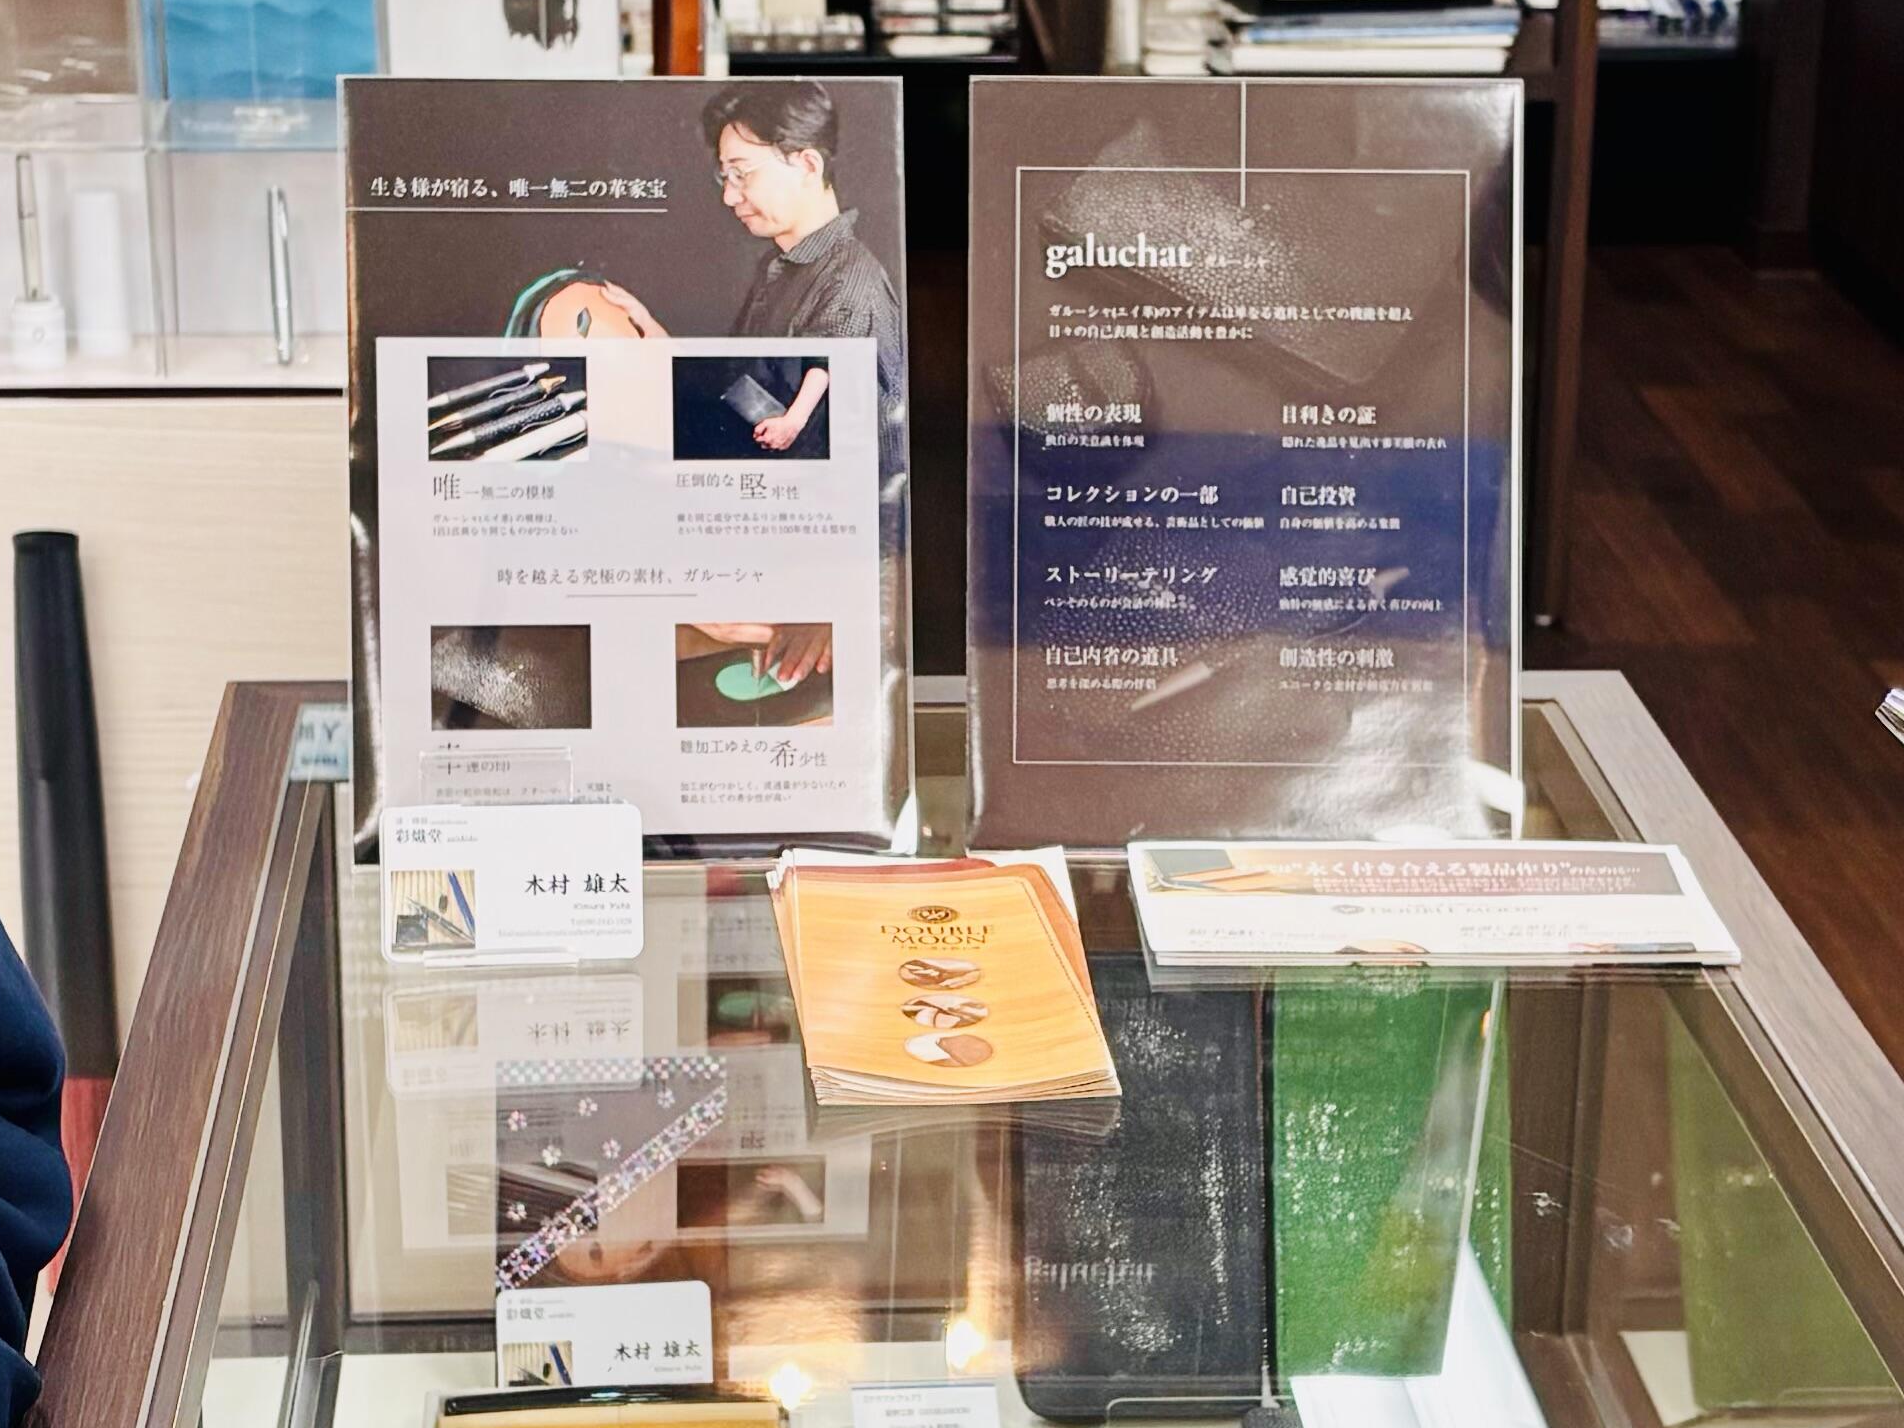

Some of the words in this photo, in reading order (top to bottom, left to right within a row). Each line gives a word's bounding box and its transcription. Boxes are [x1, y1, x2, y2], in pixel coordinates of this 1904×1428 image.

[1045, 232, 1193, 279] galuchat
[1046, 403, 1143, 424] 個性の表現
[1046, 484, 1219, 505] コレクションの一部
[1281, 485, 1356, 506] 自己投資
[1045, 565, 1219, 584] ストーリーテリング
[1279, 566, 1377, 587] 感覚的喜び
[1046, 645, 1179, 666] 自己内省の道具
[1279, 647, 1395, 669] 創造性の刺激
[524, 873, 571, 896] 木村
[583, 872, 631, 895] 雄太
[891, 934, 987, 945] MOON
